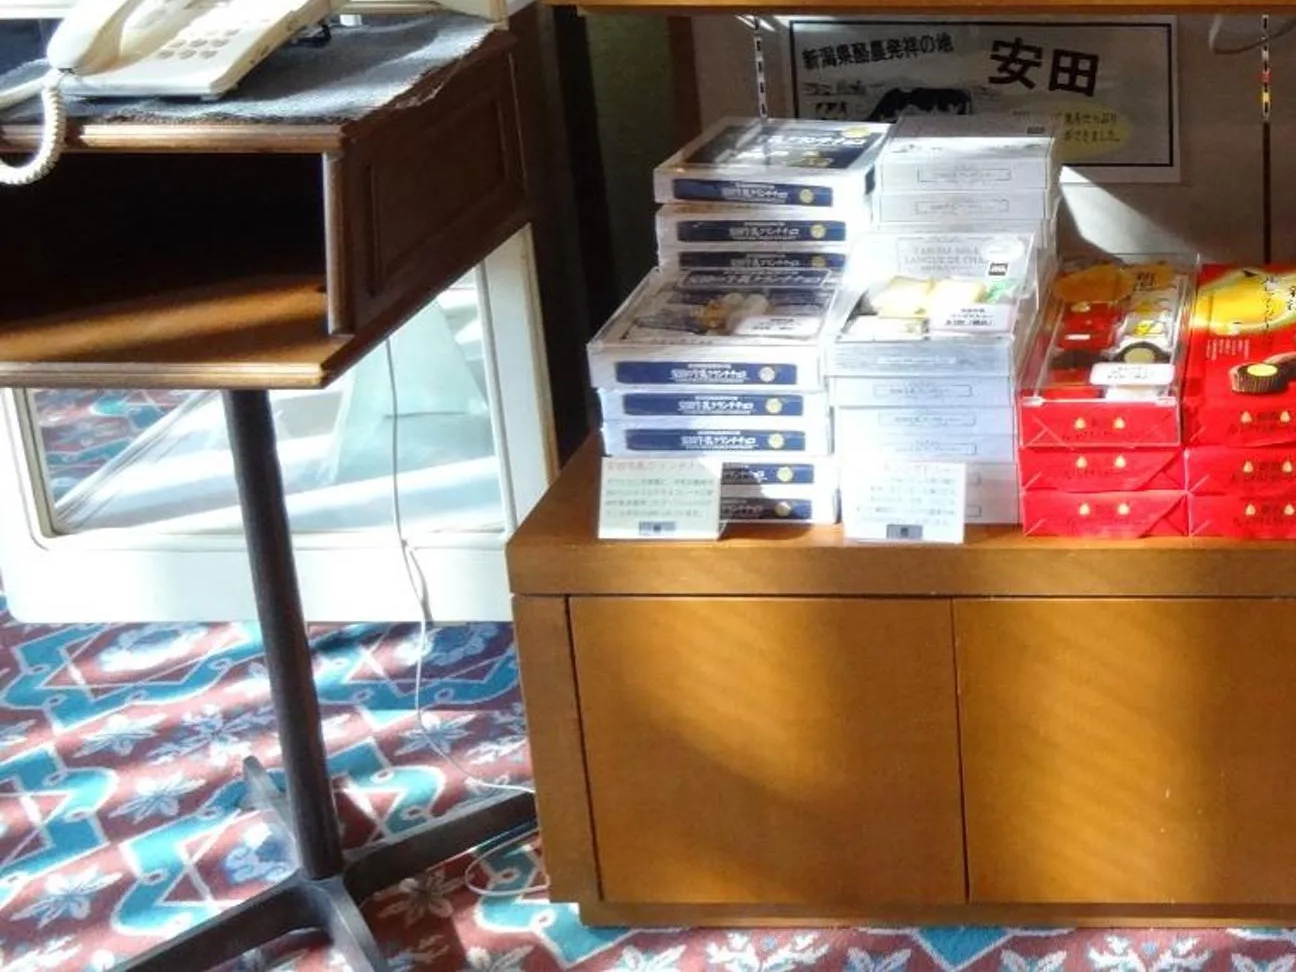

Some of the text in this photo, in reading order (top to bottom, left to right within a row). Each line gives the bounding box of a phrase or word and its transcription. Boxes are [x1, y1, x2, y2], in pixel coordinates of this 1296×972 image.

[803, 33, 955, 70] 新潟県酪農発祥の地
[988, 36, 1100, 97] 安田
